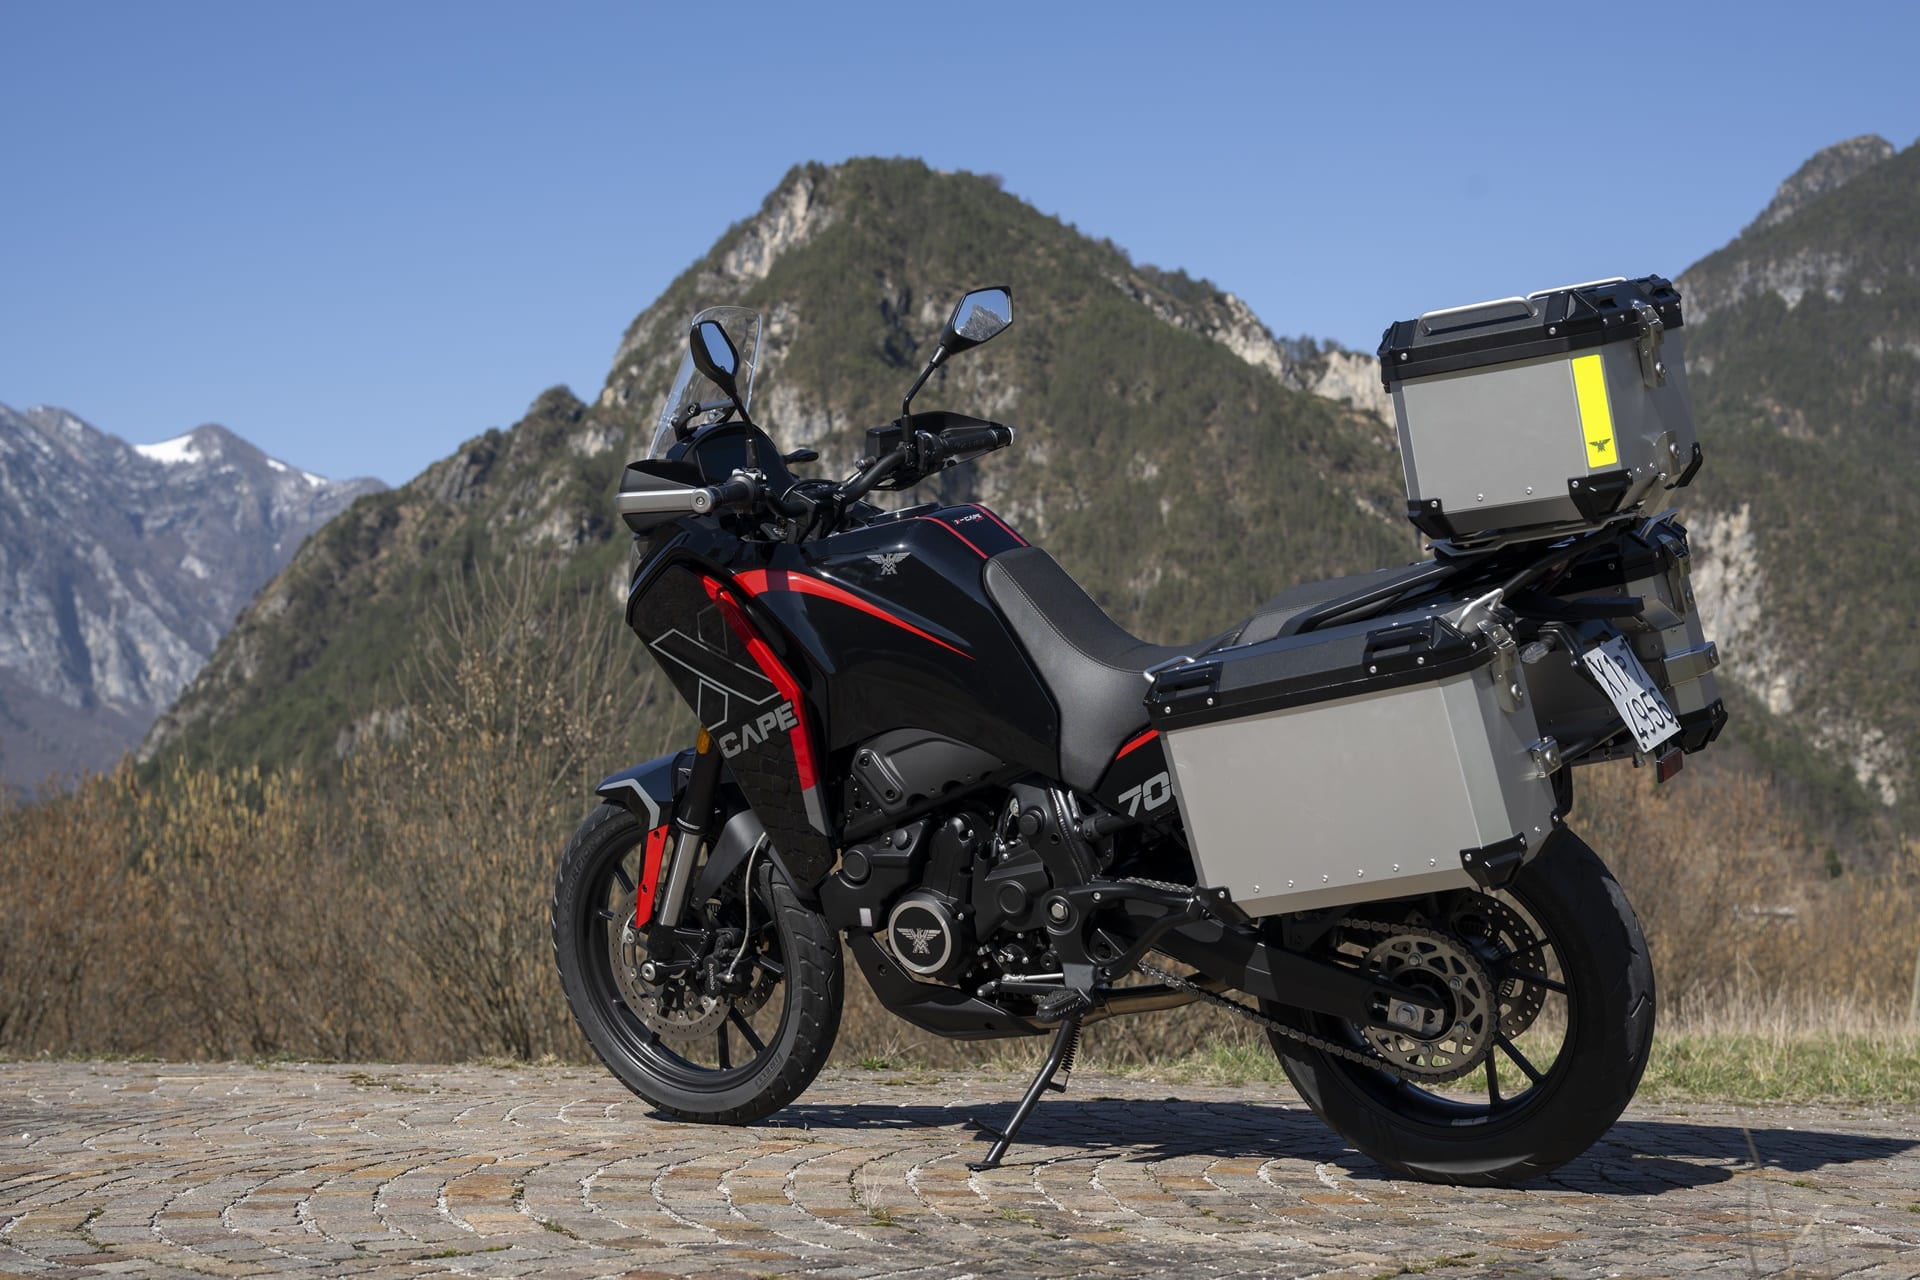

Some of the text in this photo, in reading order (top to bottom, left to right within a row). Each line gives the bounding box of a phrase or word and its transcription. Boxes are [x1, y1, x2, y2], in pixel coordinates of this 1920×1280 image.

[719, 701, 798, 759] CAPE
[1624, 687, 1675, 740] 4956
[1118, 771, 1176, 818] 70
